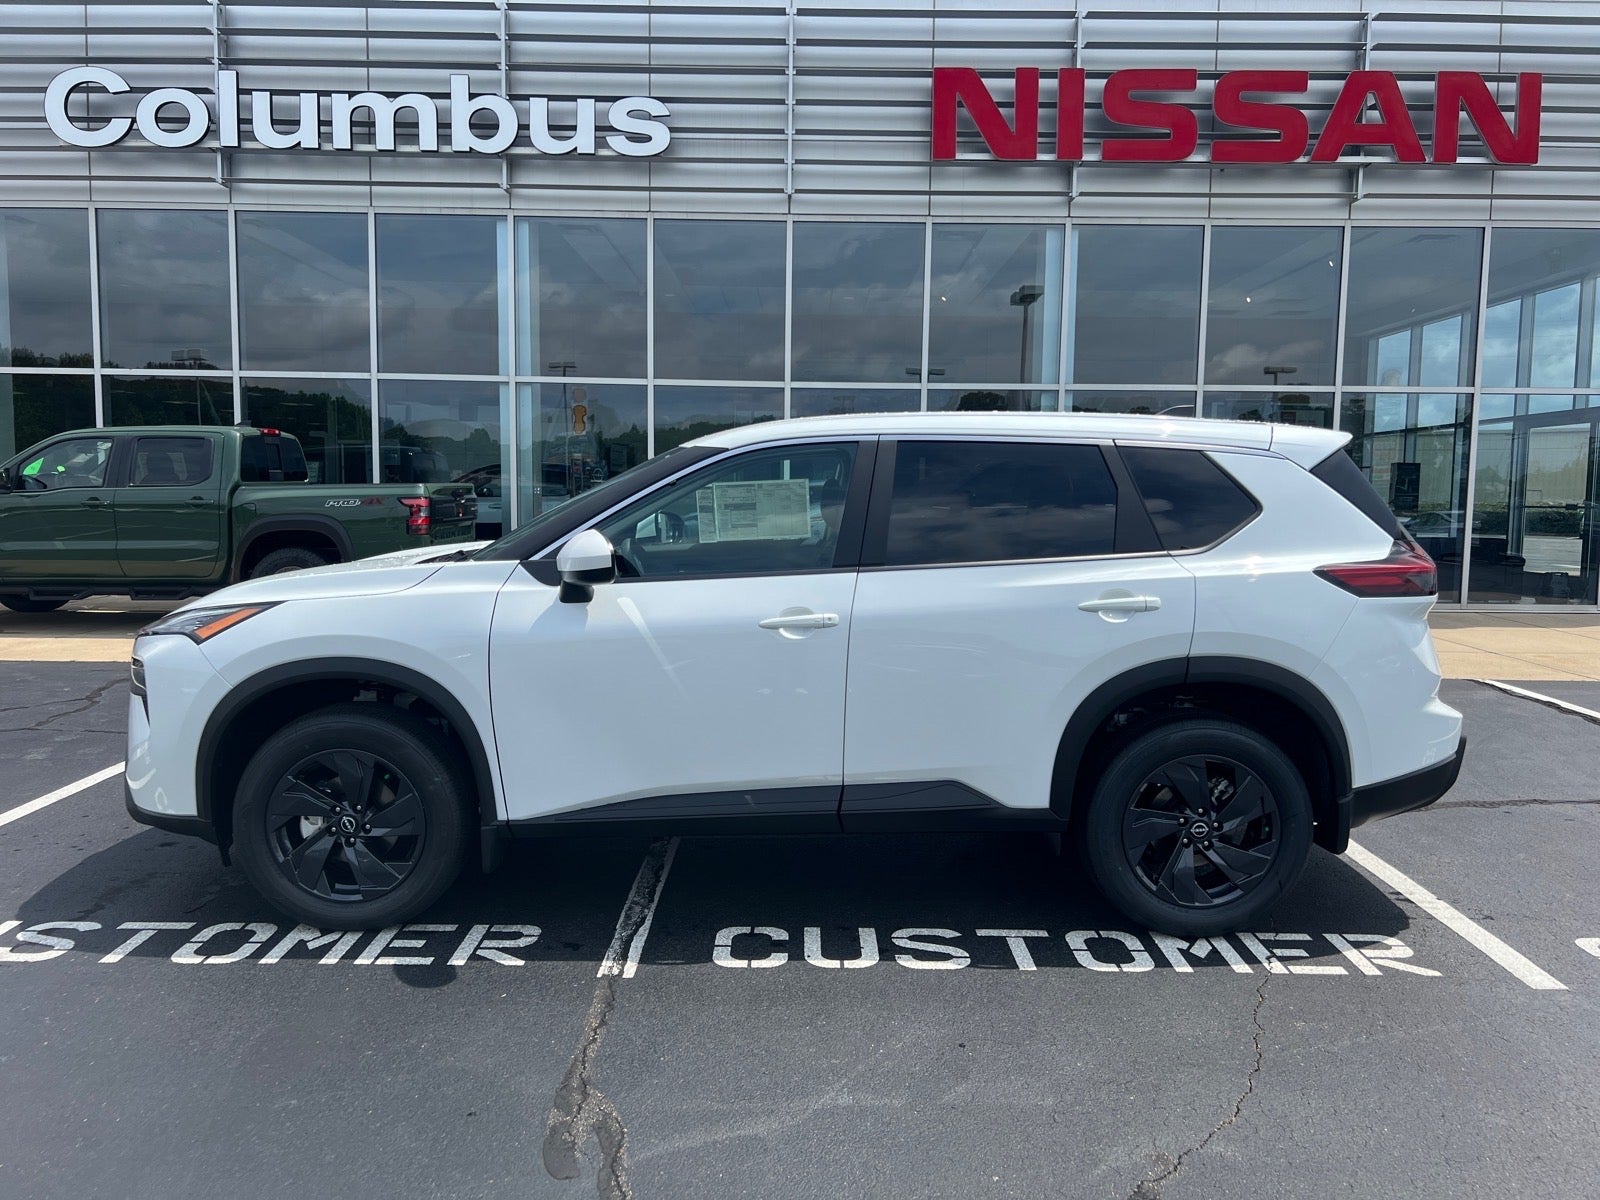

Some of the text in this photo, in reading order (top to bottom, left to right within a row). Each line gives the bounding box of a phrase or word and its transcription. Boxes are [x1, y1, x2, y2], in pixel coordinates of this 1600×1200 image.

[44, 65, 672, 157] Columbus
[931, 67, 1543, 165] NISSAN
[0, 920, 542, 966] STOMER
[712, 926, 1443, 977] CUSTOMER
